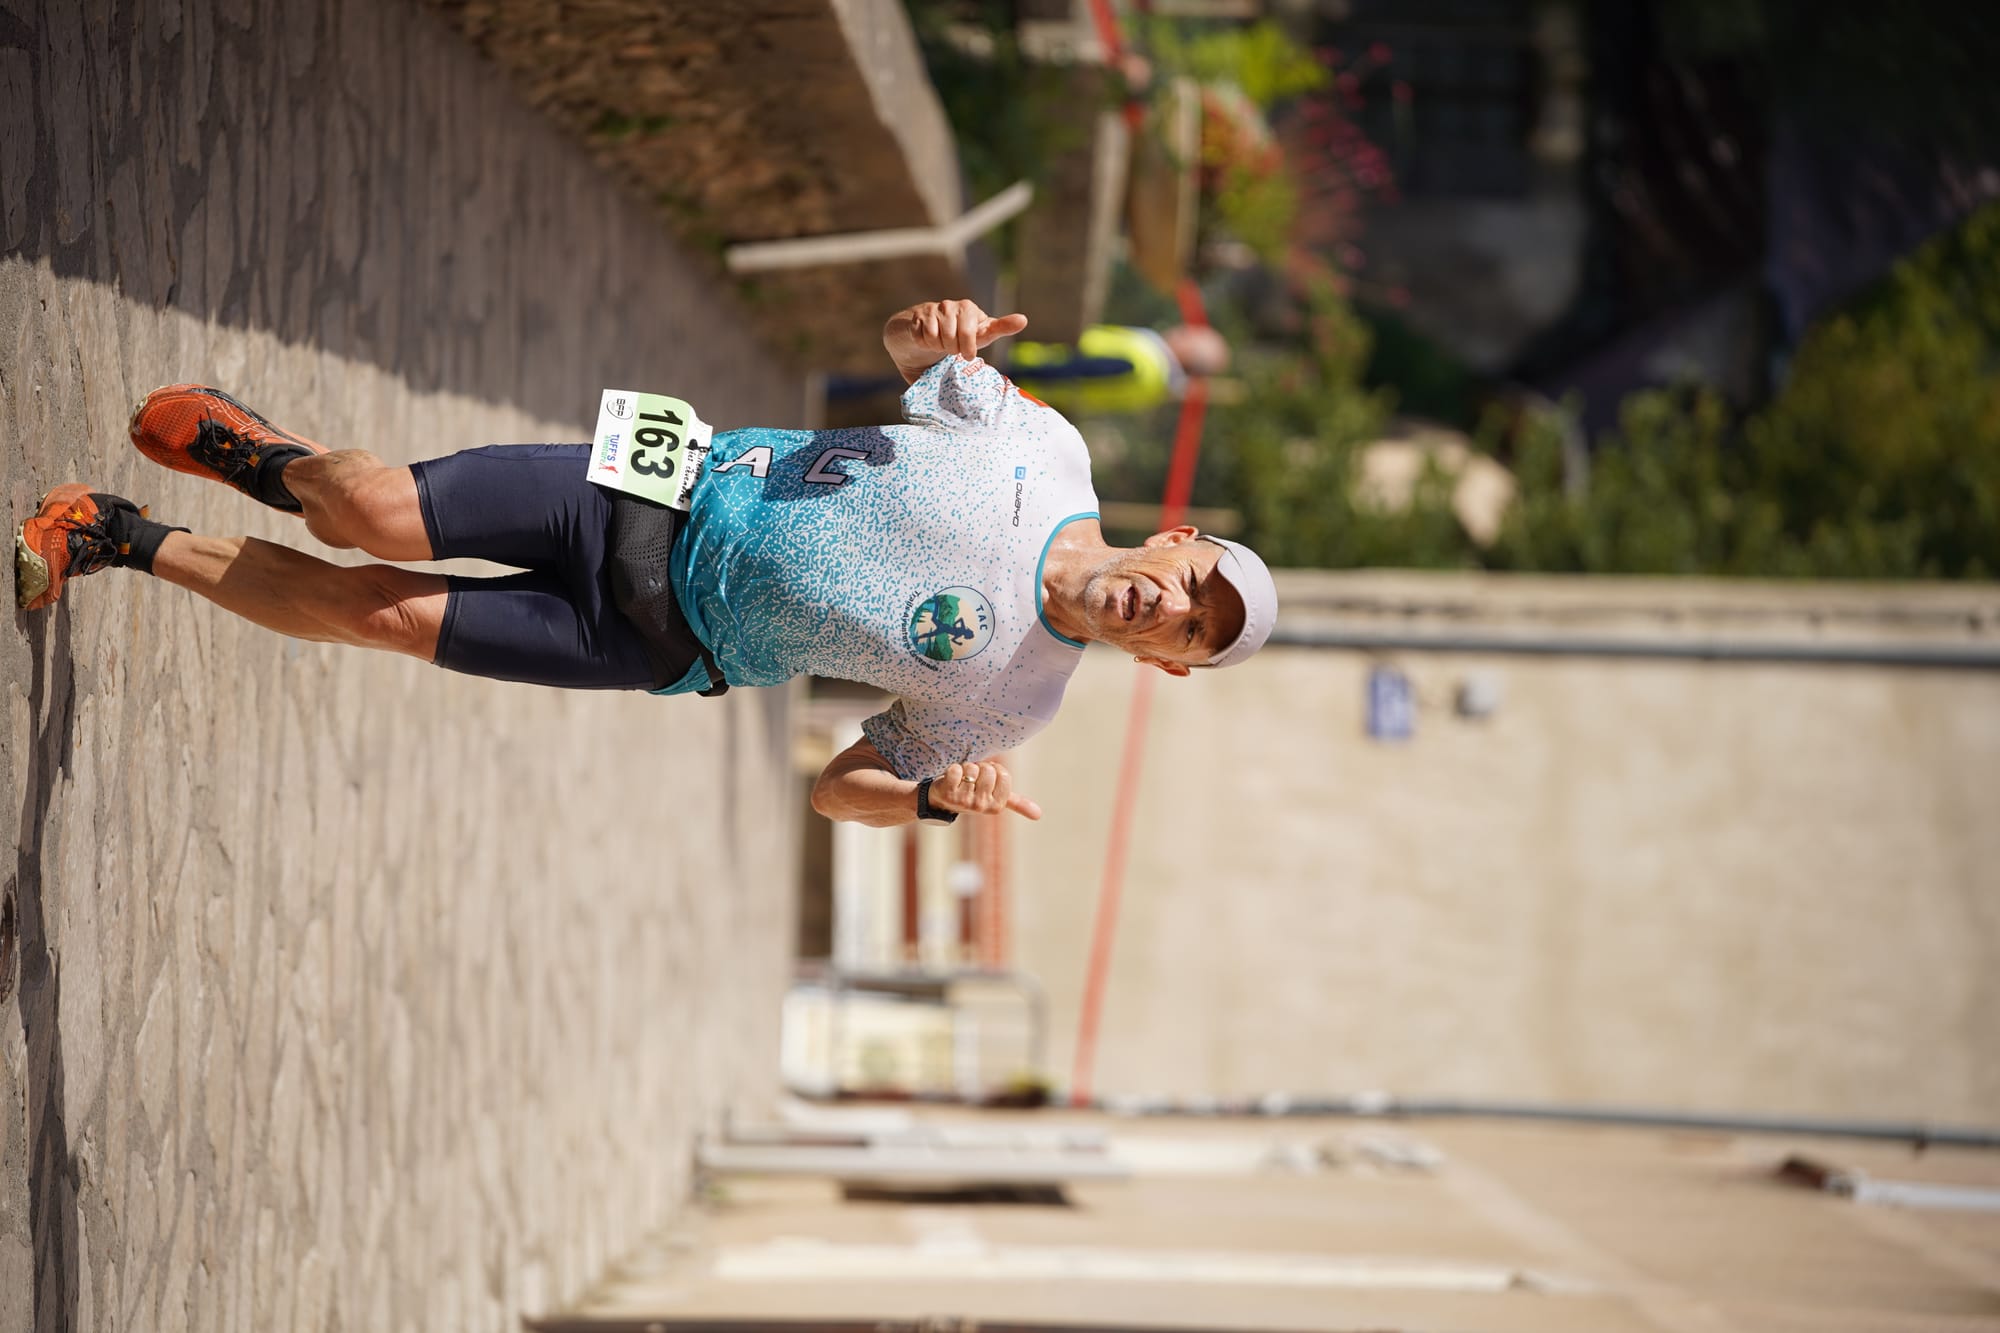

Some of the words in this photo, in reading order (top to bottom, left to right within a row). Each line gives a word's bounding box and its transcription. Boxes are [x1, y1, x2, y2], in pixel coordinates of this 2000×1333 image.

[607, 433, 620, 462] TUFF'S
[630, 409, 684, 479] 163
[1012, 482, 1023, 528] owayo
[976, 604, 988, 631] TAC
